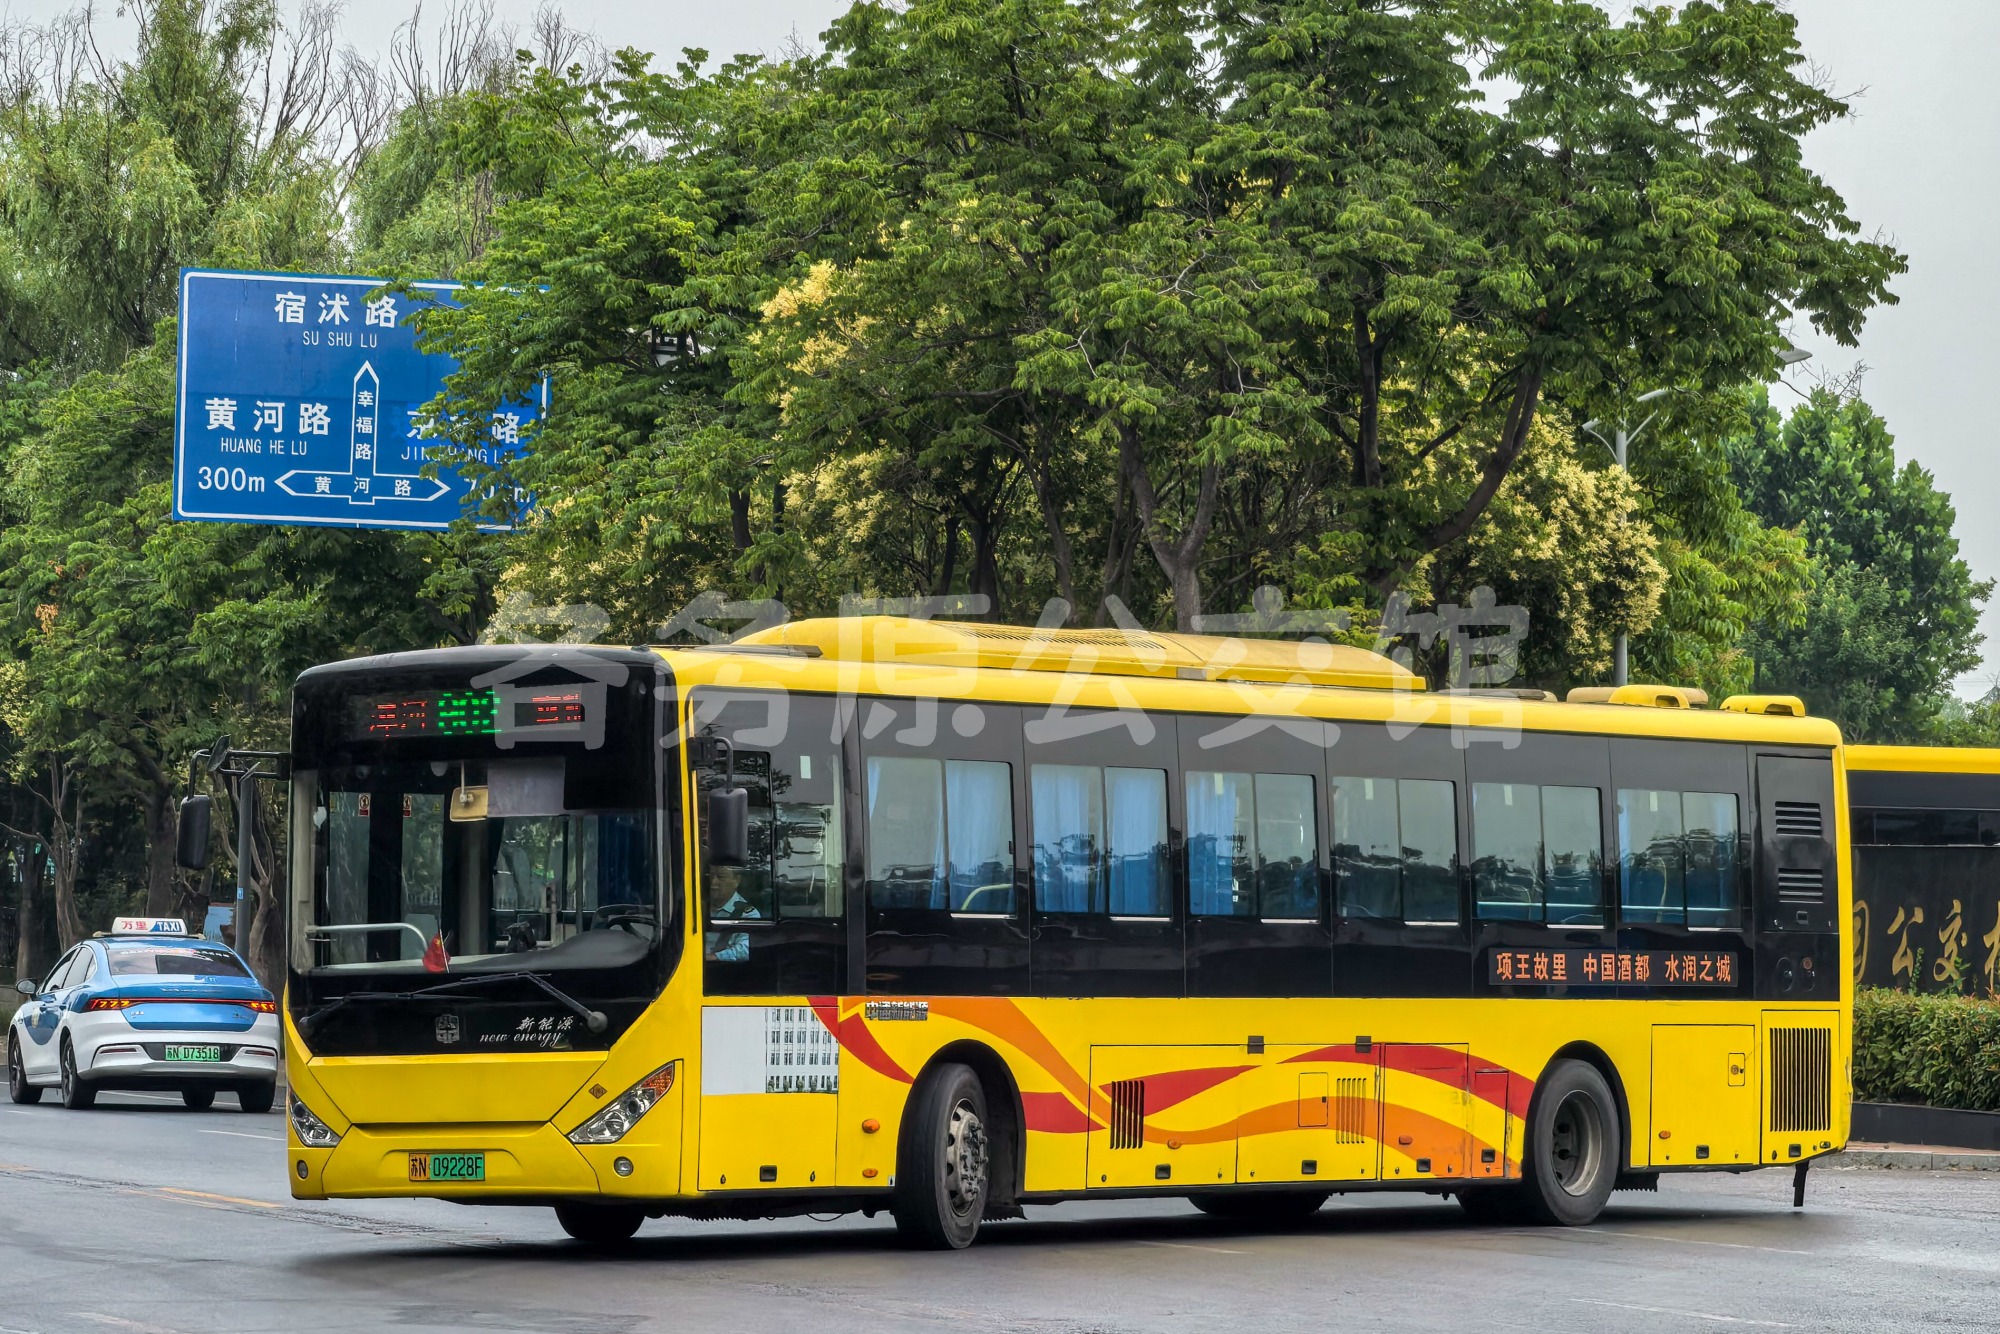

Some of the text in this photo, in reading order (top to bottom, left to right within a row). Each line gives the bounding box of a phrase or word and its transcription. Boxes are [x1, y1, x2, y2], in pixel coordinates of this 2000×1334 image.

[274, 291, 398, 328] 宿沭路
[302, 330, 378, 348] SU SHU LU
[205, 397, 331, 436] 黄河路
[355, 390, 374, 461] 幸福路
[220, 437, 307, 456] HUANG HE LU
[198, 466, 265, 493] 300m
[314, 476, 412, 497] 黄河路
[156, 921, 181, 932] TAXI
[1496, 953, 1731, 982] 项王故里 中国酒都 水润之城
[516, 1015, 574, 1032] 新能源
[479, 1031, 563, 1048] new energy
[433, 1157, 482, 1178] 09228F
